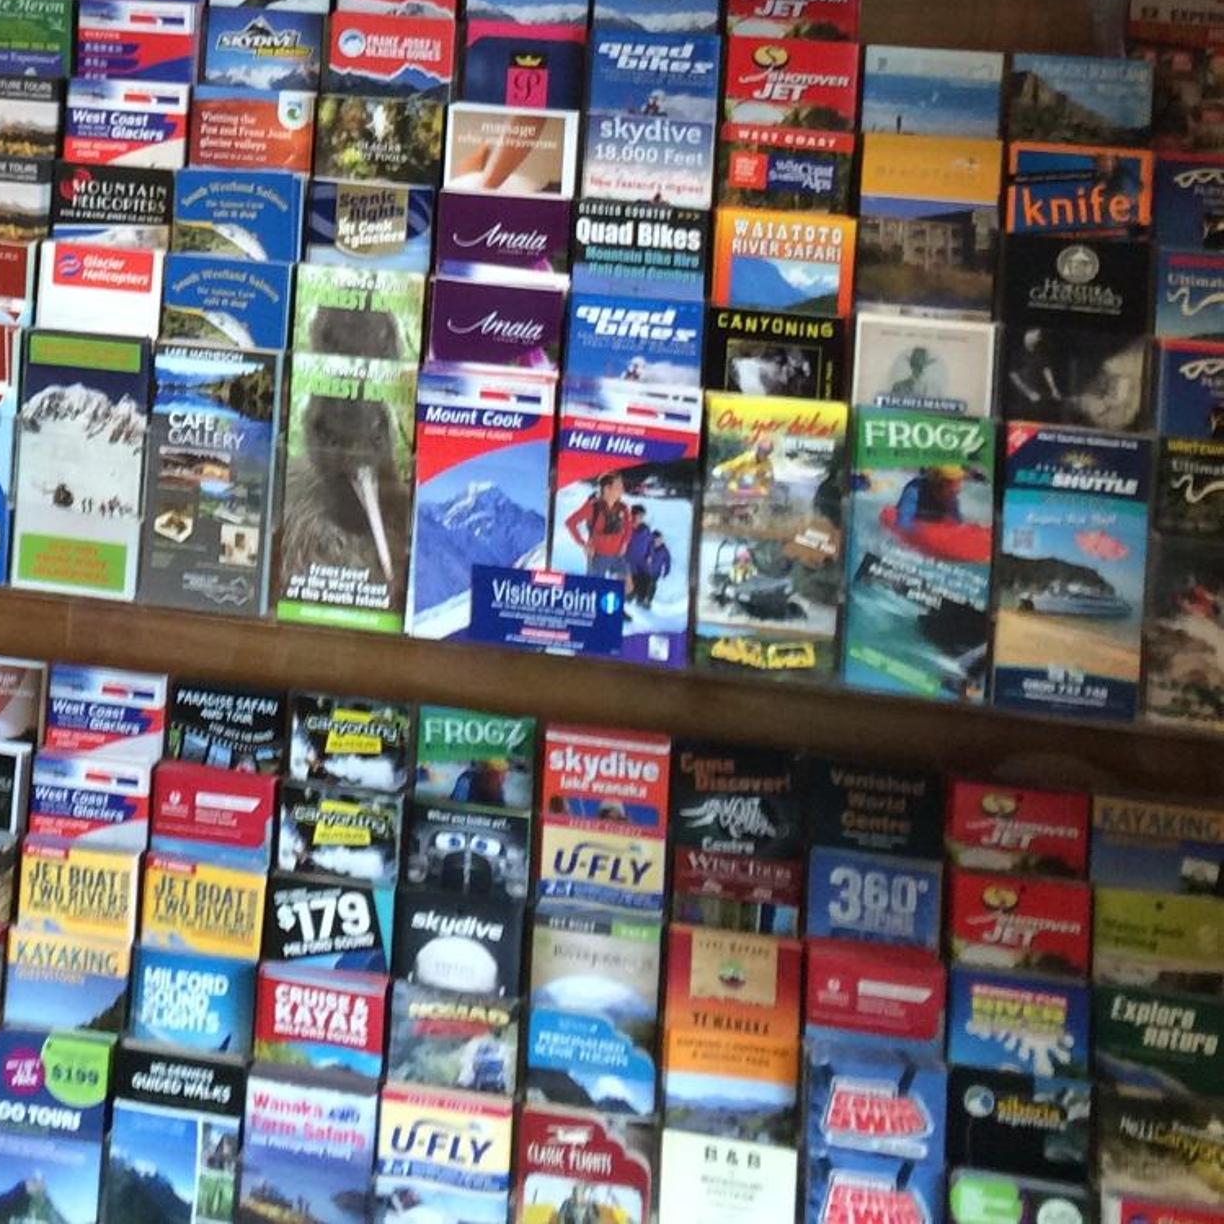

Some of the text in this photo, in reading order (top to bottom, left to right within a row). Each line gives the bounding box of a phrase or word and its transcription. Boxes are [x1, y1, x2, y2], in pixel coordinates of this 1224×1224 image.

[757, 1, 807, 17] JET
[754, 83, 807, 102] JET
[73, 110, 148, 126] West Coast
[111, 127, 164, 143] Glaciers
[600, 118, 702, 144] skydive
[594, 144, 703, 165] 18,000 Feet
[73, 179, 166, 199] MOUNTAIN
[73, 196, 166, 213] HELICOPTERS
[1023, 185, 1132, 227] knife
[577, 217, 701, 250] Quad Bikes
[734, 219, 843, 243] WAIATOTO
[732, 240, 841, 260] RIVER SAFARI
[84, 256, 125, 269] Glacier
[82, 270, 148, 286] Helicopters
[718, 316, 834, 339] CANYONING
[169, 413, 214, 428] CAFE
[426, 407, 523, 429] Mount Cook
[168, 428, 244, 449] GALLERY
[569, 432, 645, 457] Heli Hike
[865, 421, 984, 454] FROGZ
[1052, 474, 1137, 494] SHUTTLE
[492, 580, 596, 612] VisitorPoint
[53, 701, 125, 719] West Coast
[90, 718, 140, 734] Glaciers
[425, 718, 526, 748] FROGZ
[549, 748, 658, 781] skydive
[35, 787, 109, 807] West Coast
[73, 806, 124, 821] Glaciers
[277, 891, 371, 940] $179
[412, 911, 504, 941] skydive
[16, 942, 117, 973] KAYAKING
[275, 984, 348, 1010] CRUISE
[275, 1002, 368, 1036] KAYAK
[1110, 995, 1196, 1029] Explore
[184, 1082, 232, 1102] WALKS
